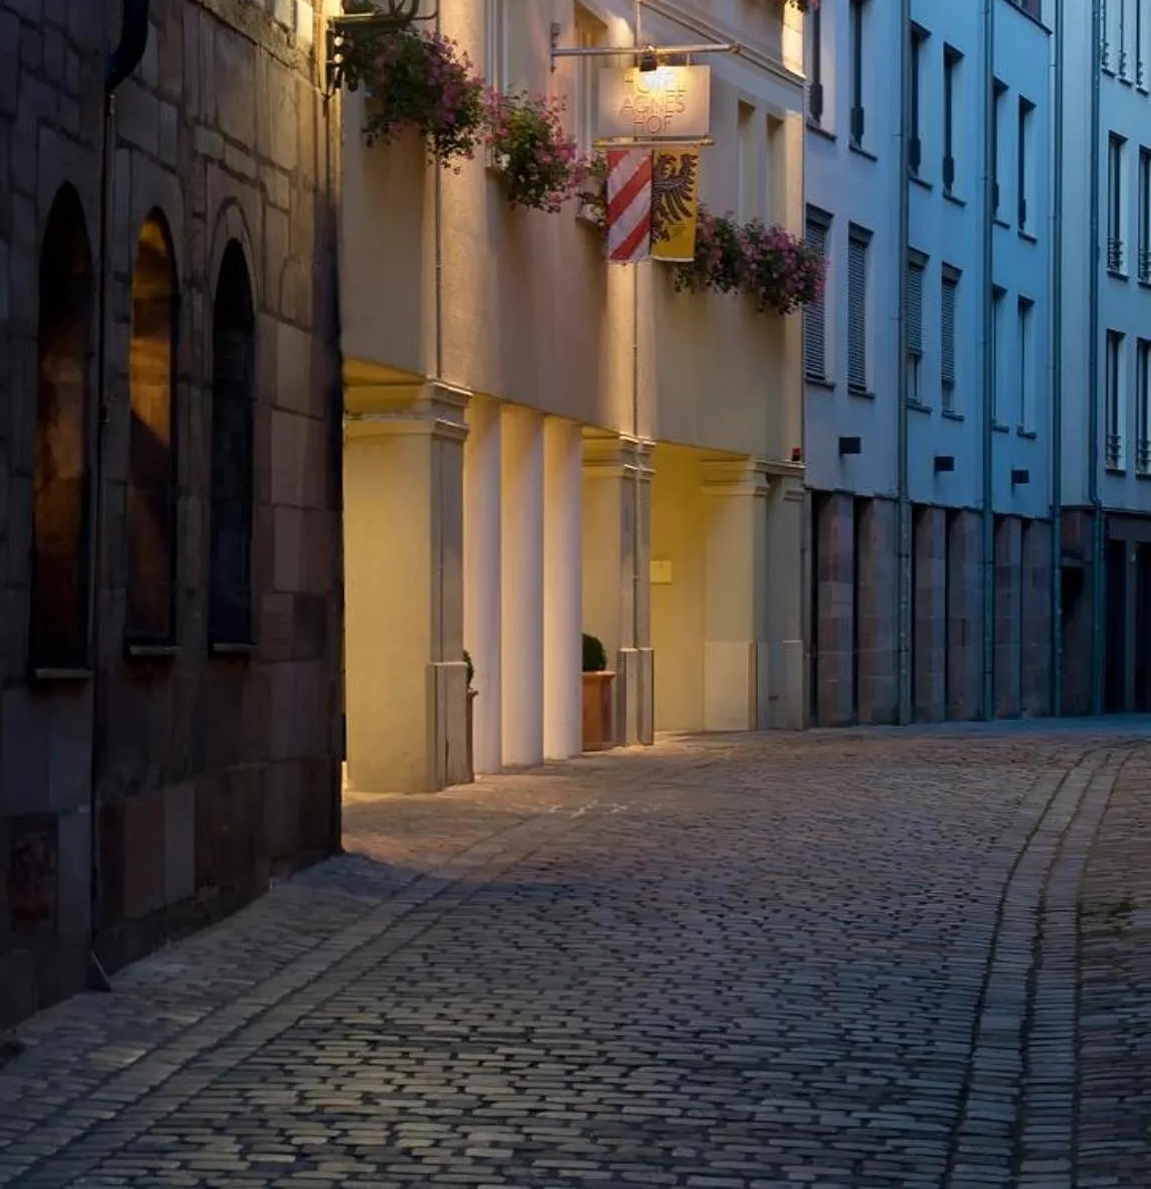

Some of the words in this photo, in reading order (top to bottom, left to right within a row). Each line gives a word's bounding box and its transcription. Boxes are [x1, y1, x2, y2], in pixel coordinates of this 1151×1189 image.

[624, 72, 688, 94] HOEL
[618, 94, 686, 115] AGNES
[632, 114, 674, 135] HOF
